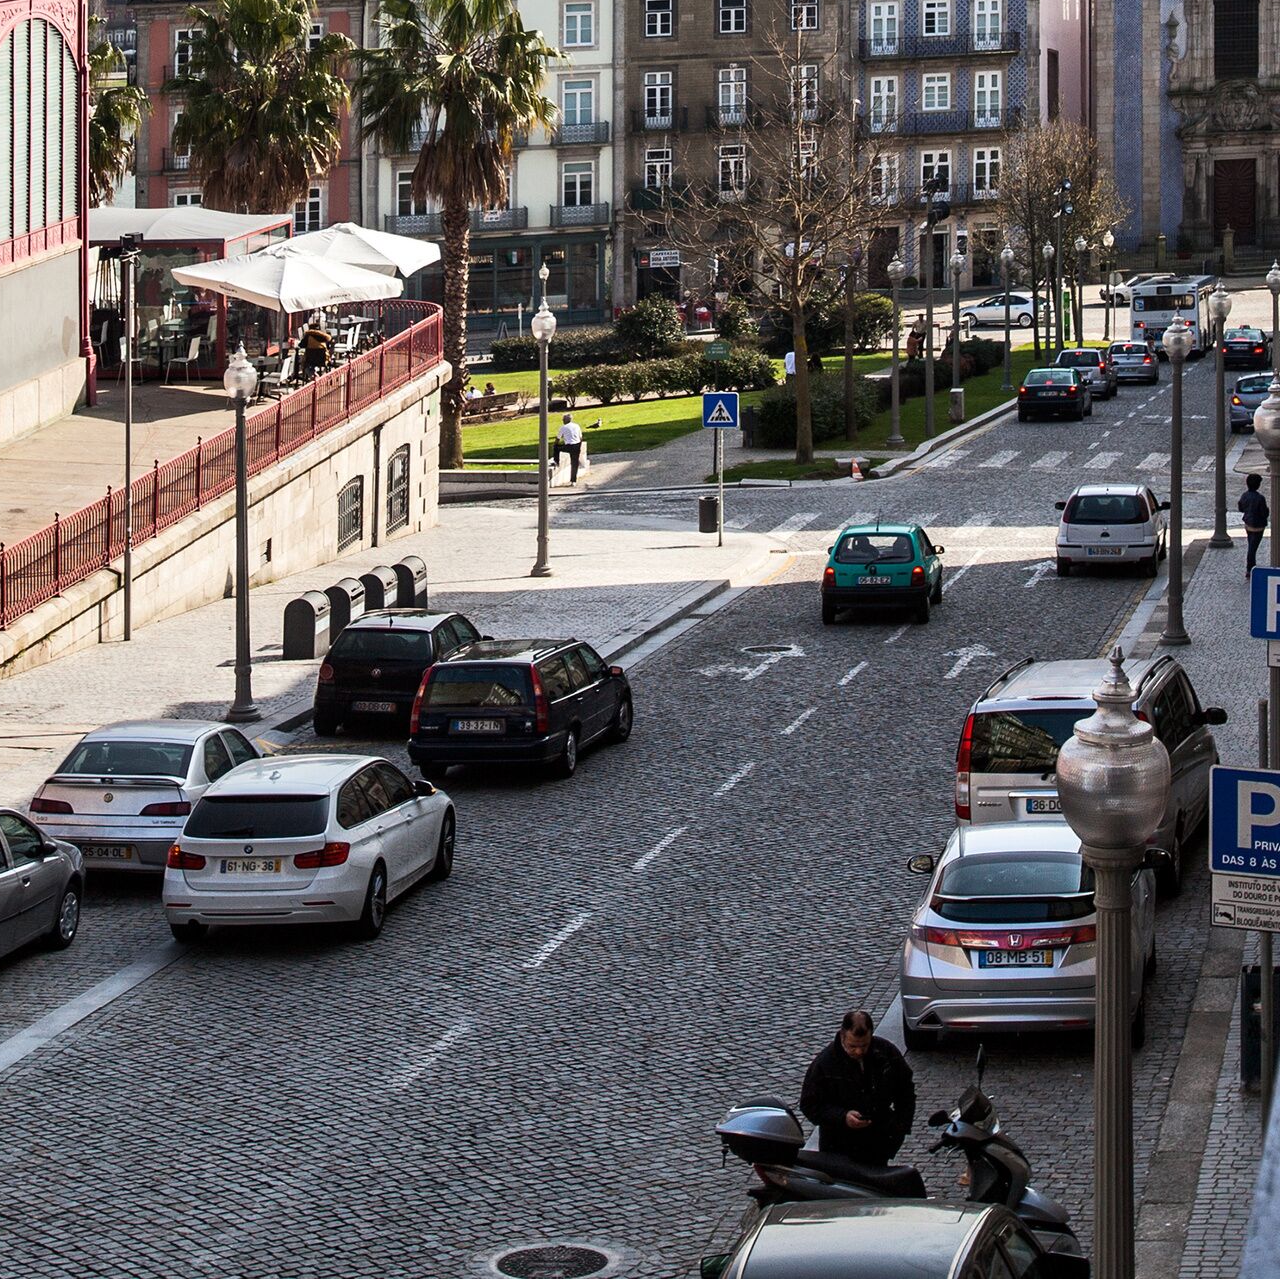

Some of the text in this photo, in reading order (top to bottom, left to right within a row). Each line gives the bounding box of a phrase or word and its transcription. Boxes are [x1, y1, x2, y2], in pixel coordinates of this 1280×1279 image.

[227, 861, 274, 871] 61-NG-36
[1222, 854, 1245, 866] DAS
[1249, 857, 1257, 867] 8
[1261, 856, 1277, 869] ÀS
[1228, 880, 1261, 891] INSTITUTO
[1262, 883, 1276, 892] DOS
[1233, 891, 1242, 899] DO
[1243, 892, 1268, 901] DOURO
[987, 950, 1045, 963] 08-MB-51
